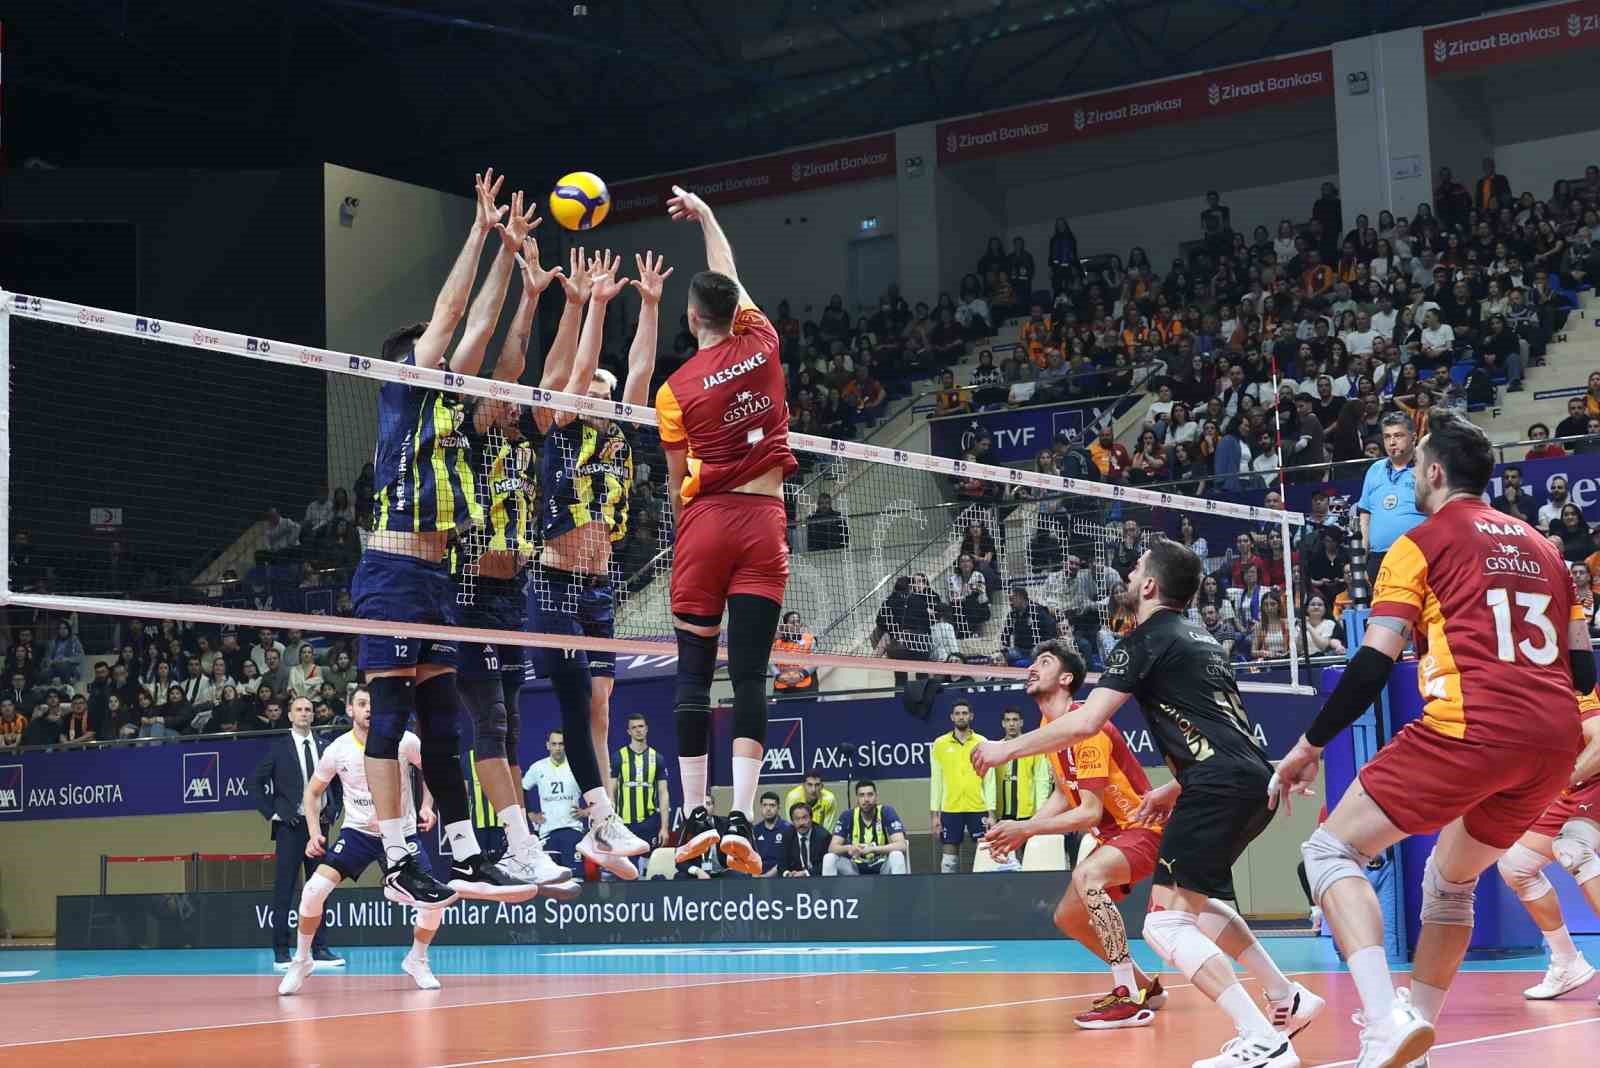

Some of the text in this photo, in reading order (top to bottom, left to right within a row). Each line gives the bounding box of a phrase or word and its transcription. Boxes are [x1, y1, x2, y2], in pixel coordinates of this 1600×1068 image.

[1583, 14, 1600, 31] Zi
[1449, 25, 1561, 56] Ziraat Bankası
[1221, 71, 1323, 100] Ziraat Bankası
[1086, 98, 1183, 124] Ziraat Bankası
[959, 122, 1049, 147] Ziraat Bankası
[802, 159, 840, 177] Ziraat
[703, 352, 768, 390] JAESCHKE
[993, 427, 1036, 449] TVF
[1474, 520, 1528, 537] MAAR
[1485, 588, 1559, 666] 13
[394, 644, 408, 657] 12
[485, 657, 498, 670] 10
[1123, 730, 1154, 753] XA
[761, 747, 796, 770] AXA
[858, 740, 933, 767] SİGORT
[28, 783, 123, 807] AXA SİGORTA
[184, 777, 213, 798] AXA
[225, 777, 249, 797] AX
[550, 781, 564, 794] 21
[350, 900, 392, 927] Milli
[398, 900, 489, 926] Tamlar
[495, 901, 537, 925] Ana
[544, 899, 654, 930] Sponsoru
[663, 893, 859, 922] Mercedes-Benz
